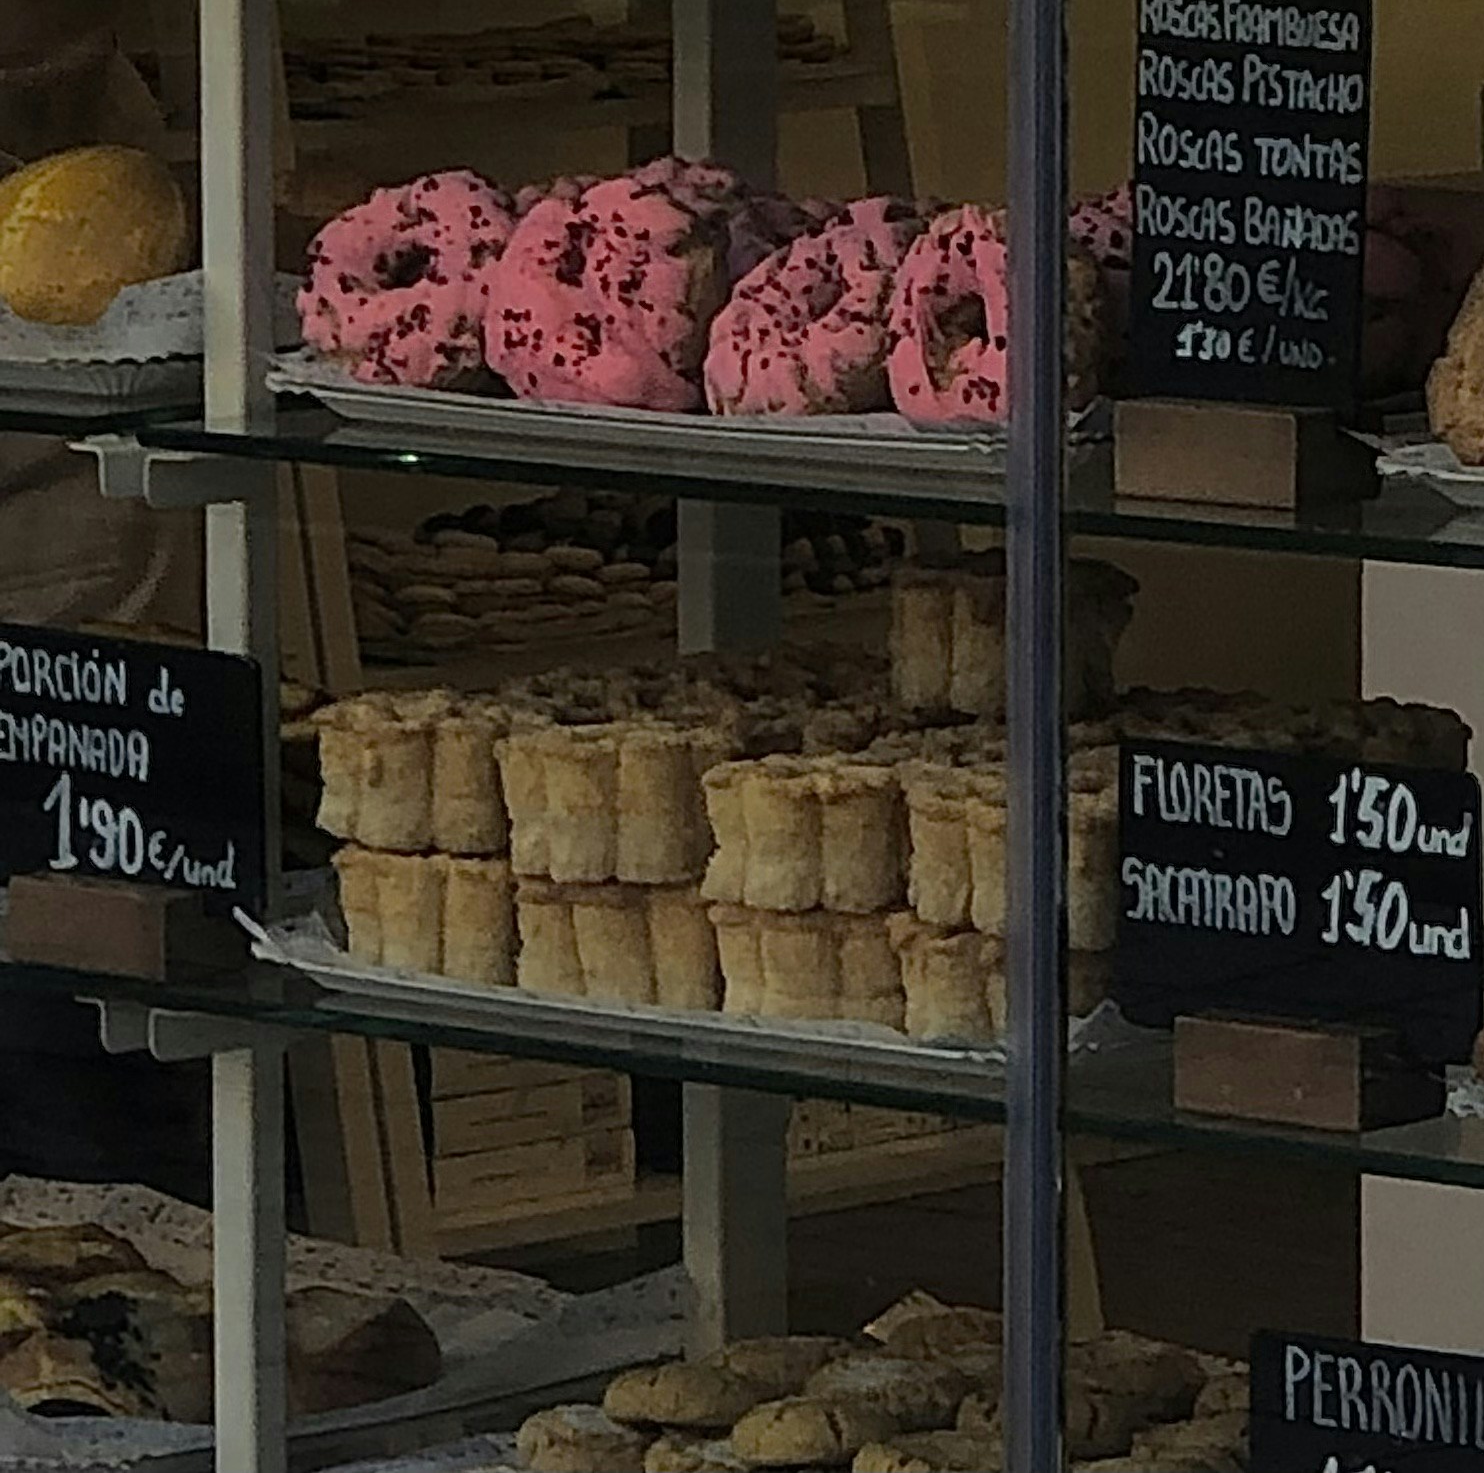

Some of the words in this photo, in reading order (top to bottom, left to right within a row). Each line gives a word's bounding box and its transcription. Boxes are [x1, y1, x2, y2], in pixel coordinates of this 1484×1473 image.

[1139, 48, 1235, 105] ROSCAS
[1138, 110, 1243, 174] ROSCAS
[1253, 133, 1364, 185] TONTAS
[1136, 183, 1236, 245] ROSCAS
[148, 664, 186, 717] de
[1132, 754, 1293, 836] FLORETAS
